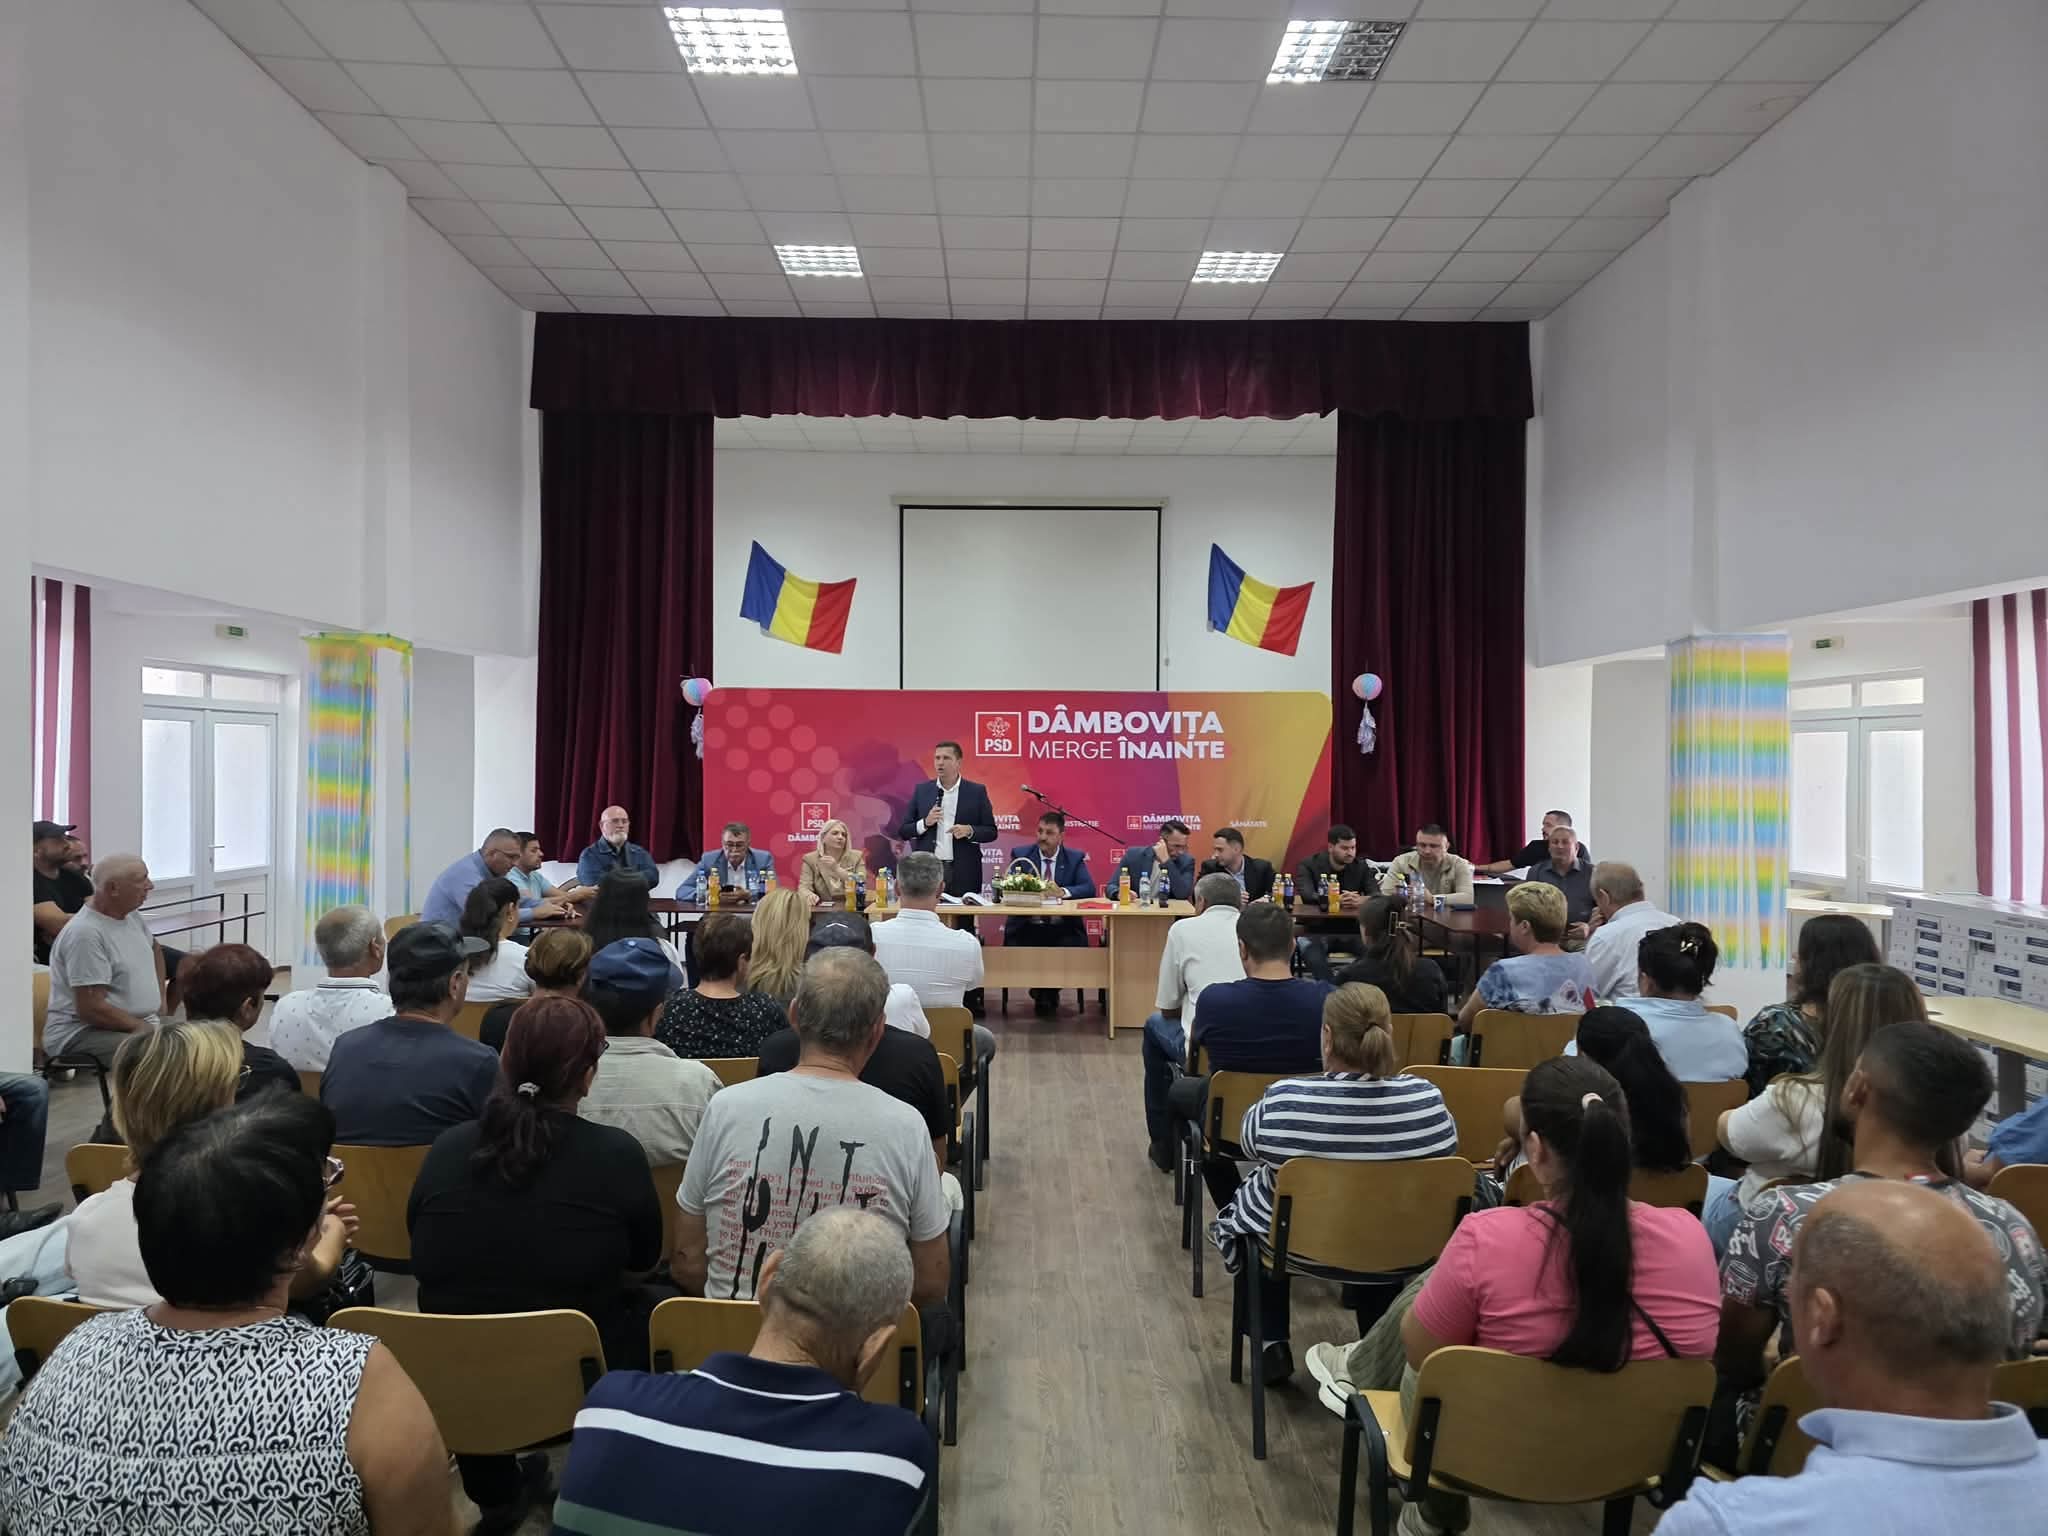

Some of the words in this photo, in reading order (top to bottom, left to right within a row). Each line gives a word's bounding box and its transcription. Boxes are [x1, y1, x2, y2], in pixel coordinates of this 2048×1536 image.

[1027, 704, 1225, 738] DÂMBOVIȚA
[984, 738, 1013, 752] PSD
[1029, 741, 1112, 759] MERGE
[1117, 736, 1225, 759] ÎNAINTE
